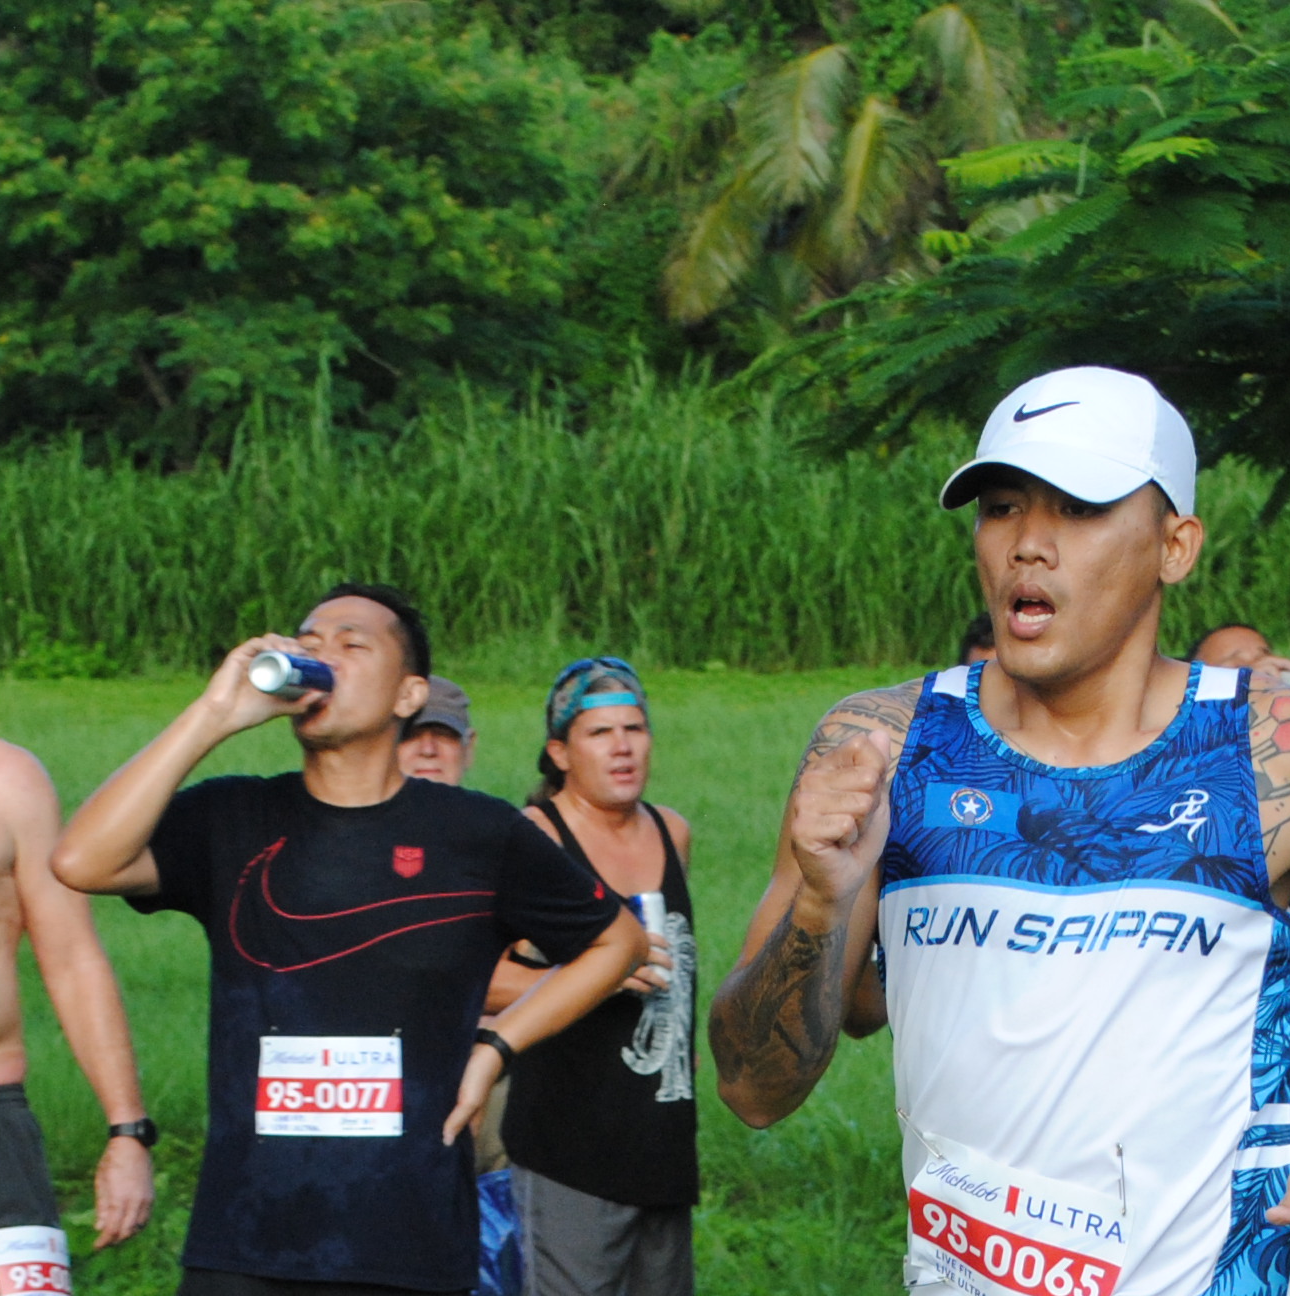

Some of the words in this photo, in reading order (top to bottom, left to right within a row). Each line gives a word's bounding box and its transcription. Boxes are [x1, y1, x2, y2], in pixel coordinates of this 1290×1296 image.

[903, 907, 999, 947] RUN
[1007, 911, 1224, 957] SAIPAN
[266, 1081, 391, 1110] 95-0077
[925, 1160, 999, 1203] Michelob
[1025, 1195, 1125, 1244] ULTRA
[935, 1249, 957, 1270] LIVE
